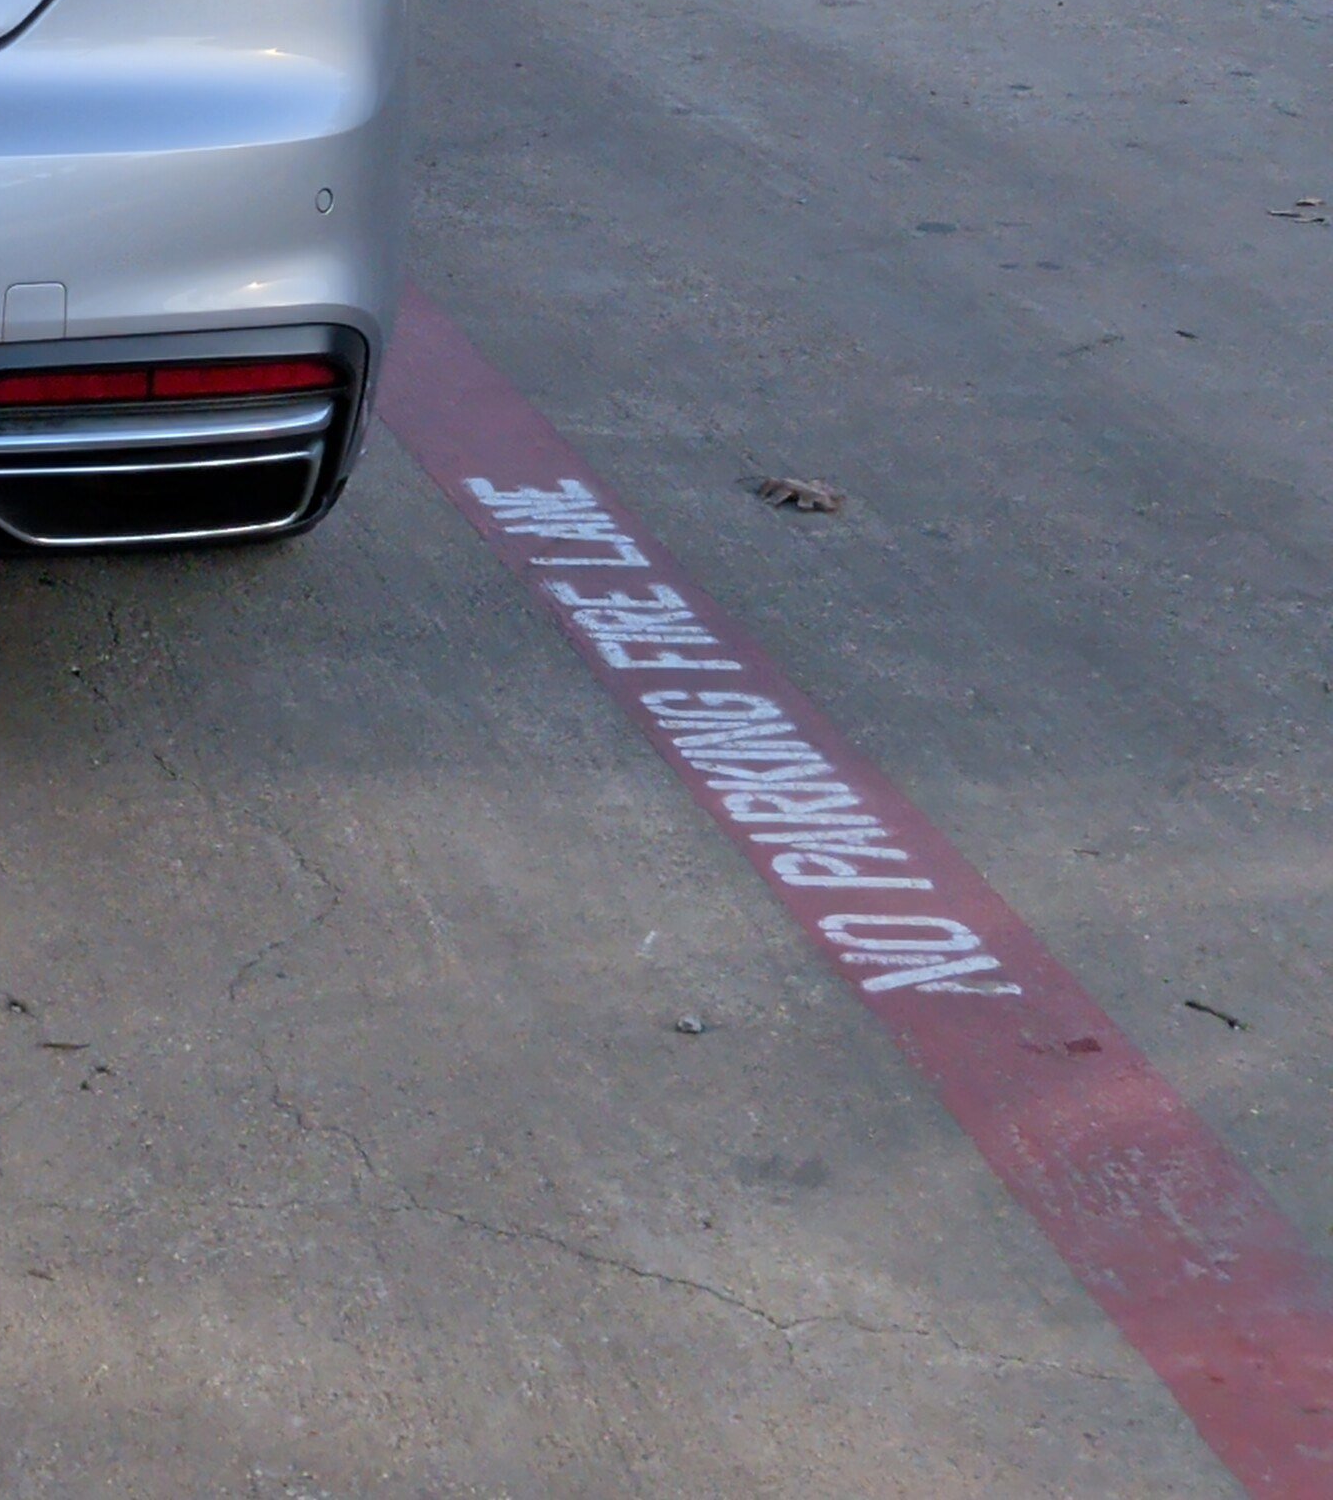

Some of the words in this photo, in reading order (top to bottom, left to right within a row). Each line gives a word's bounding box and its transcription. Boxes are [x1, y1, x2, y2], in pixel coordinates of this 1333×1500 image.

[462, 476, 651, 567] LANE
[541, 580, 742, 670] FIRE
[639, 690, 934, 890] PARKING
[817, 913, 1023, 997] NO
